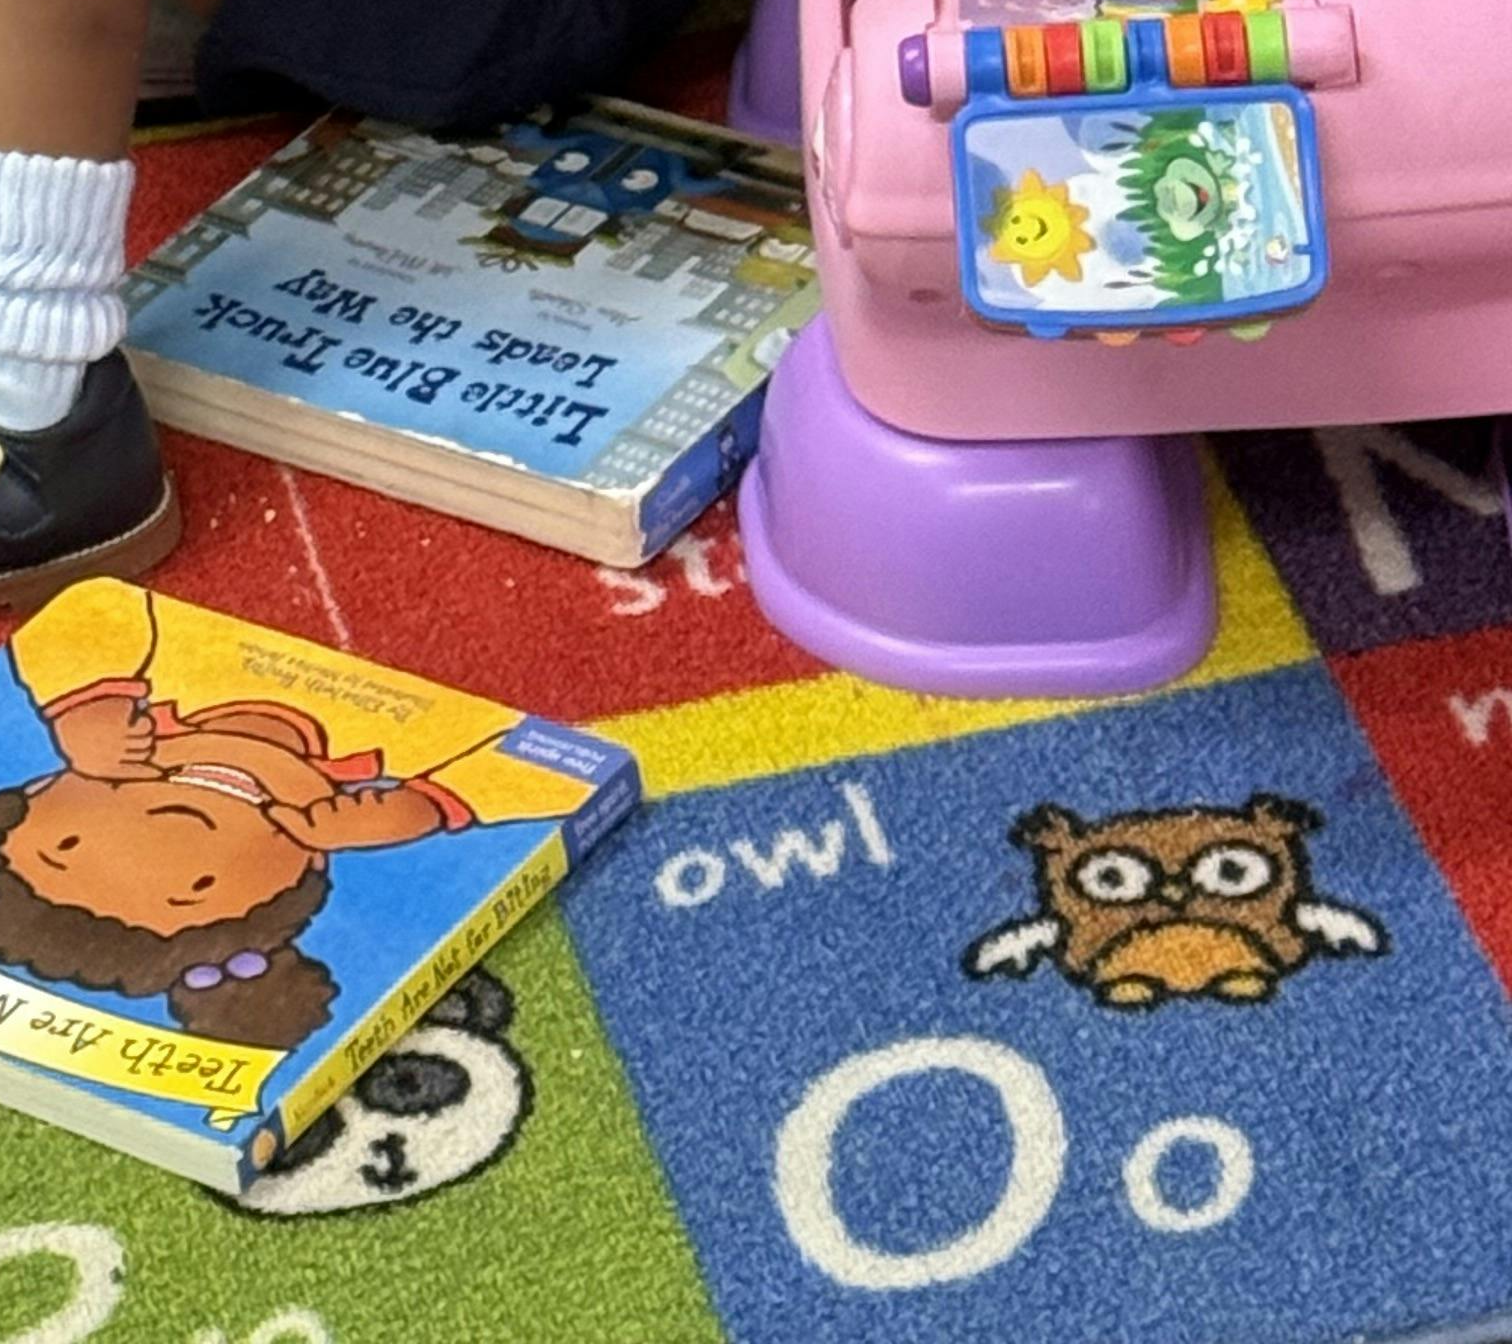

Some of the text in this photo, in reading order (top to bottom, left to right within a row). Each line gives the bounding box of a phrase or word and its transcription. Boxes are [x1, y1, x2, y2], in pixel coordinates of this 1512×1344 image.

[273, 267, 378, 324] Way
[388, 305, 463, 345] the
[195, 292, 609, 447] Little Blue Truck
[471, 327, 619, 389] Leads
[656, 782, 897, 909] owl
[343, 864, 553, 1076] Teeth Are Not for Biting
[29, 1009, 114, 1055] Are
[120, 1036, 251, 1096] Teeth
[773, 1034, 1256, 1290] O o
